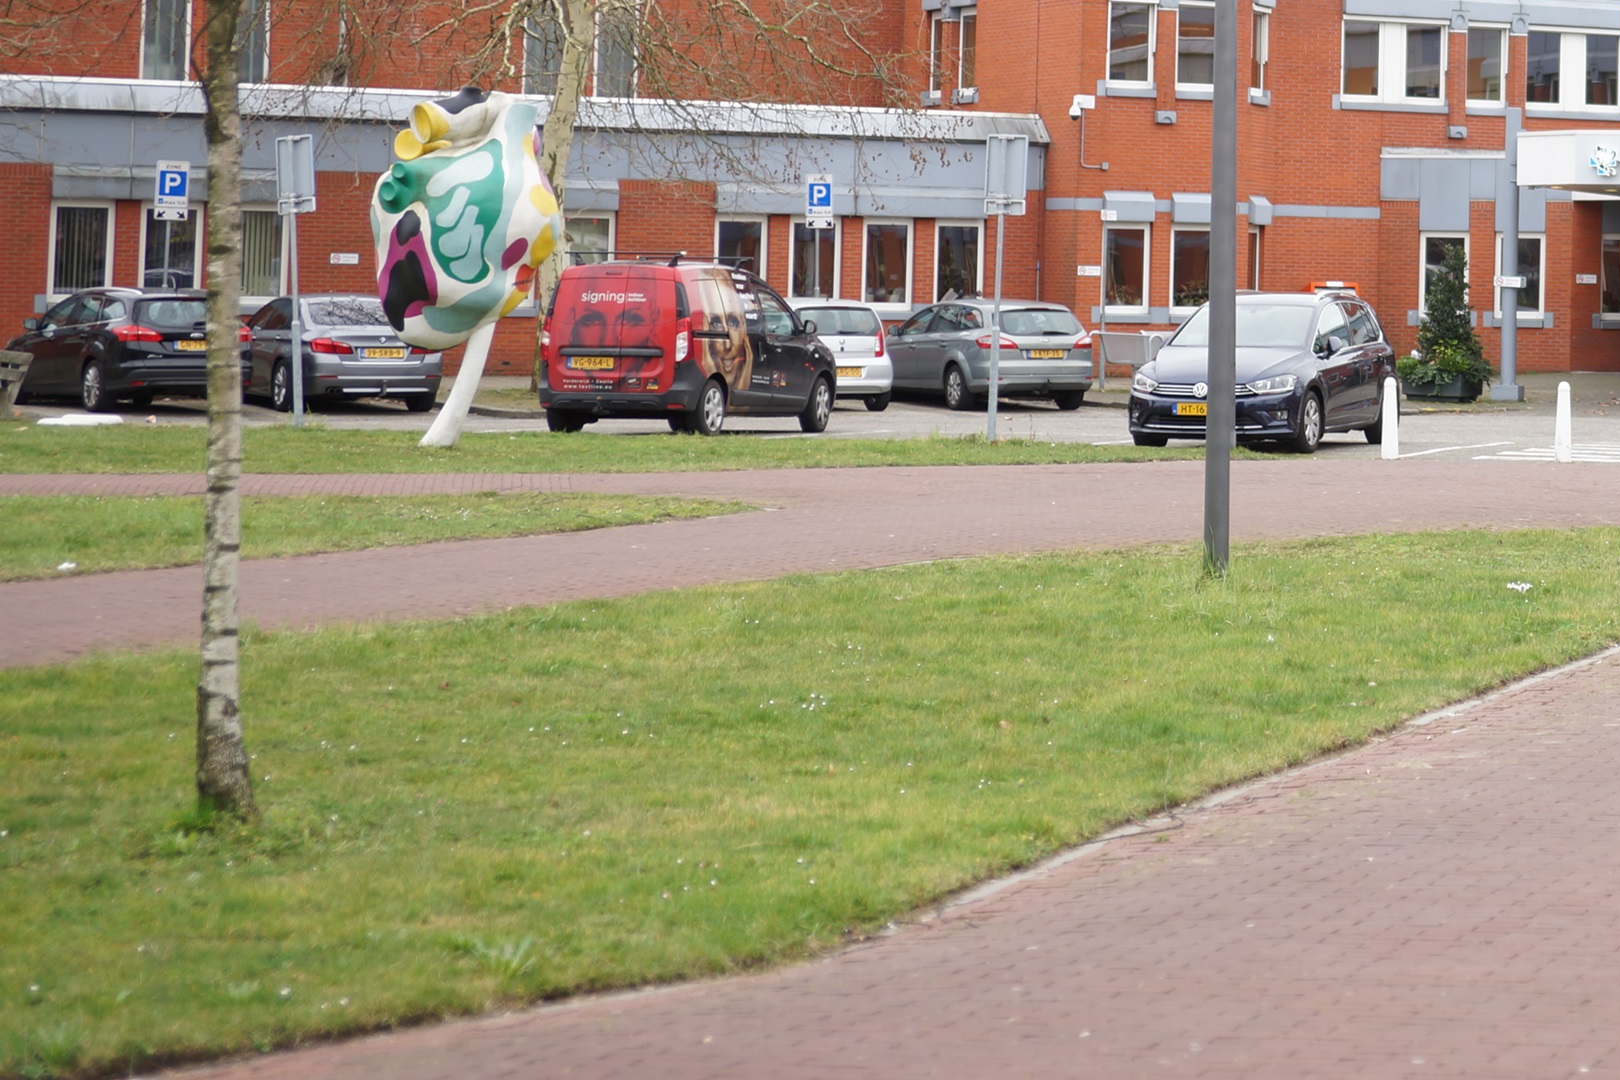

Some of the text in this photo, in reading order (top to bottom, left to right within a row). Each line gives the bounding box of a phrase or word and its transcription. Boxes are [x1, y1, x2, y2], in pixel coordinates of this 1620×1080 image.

[164, 173, 182, 194] P
[813, 185, 827, 205] P
[581, 290, 625, 304] signing
[573, 357, 611, 367] VG-964-L
